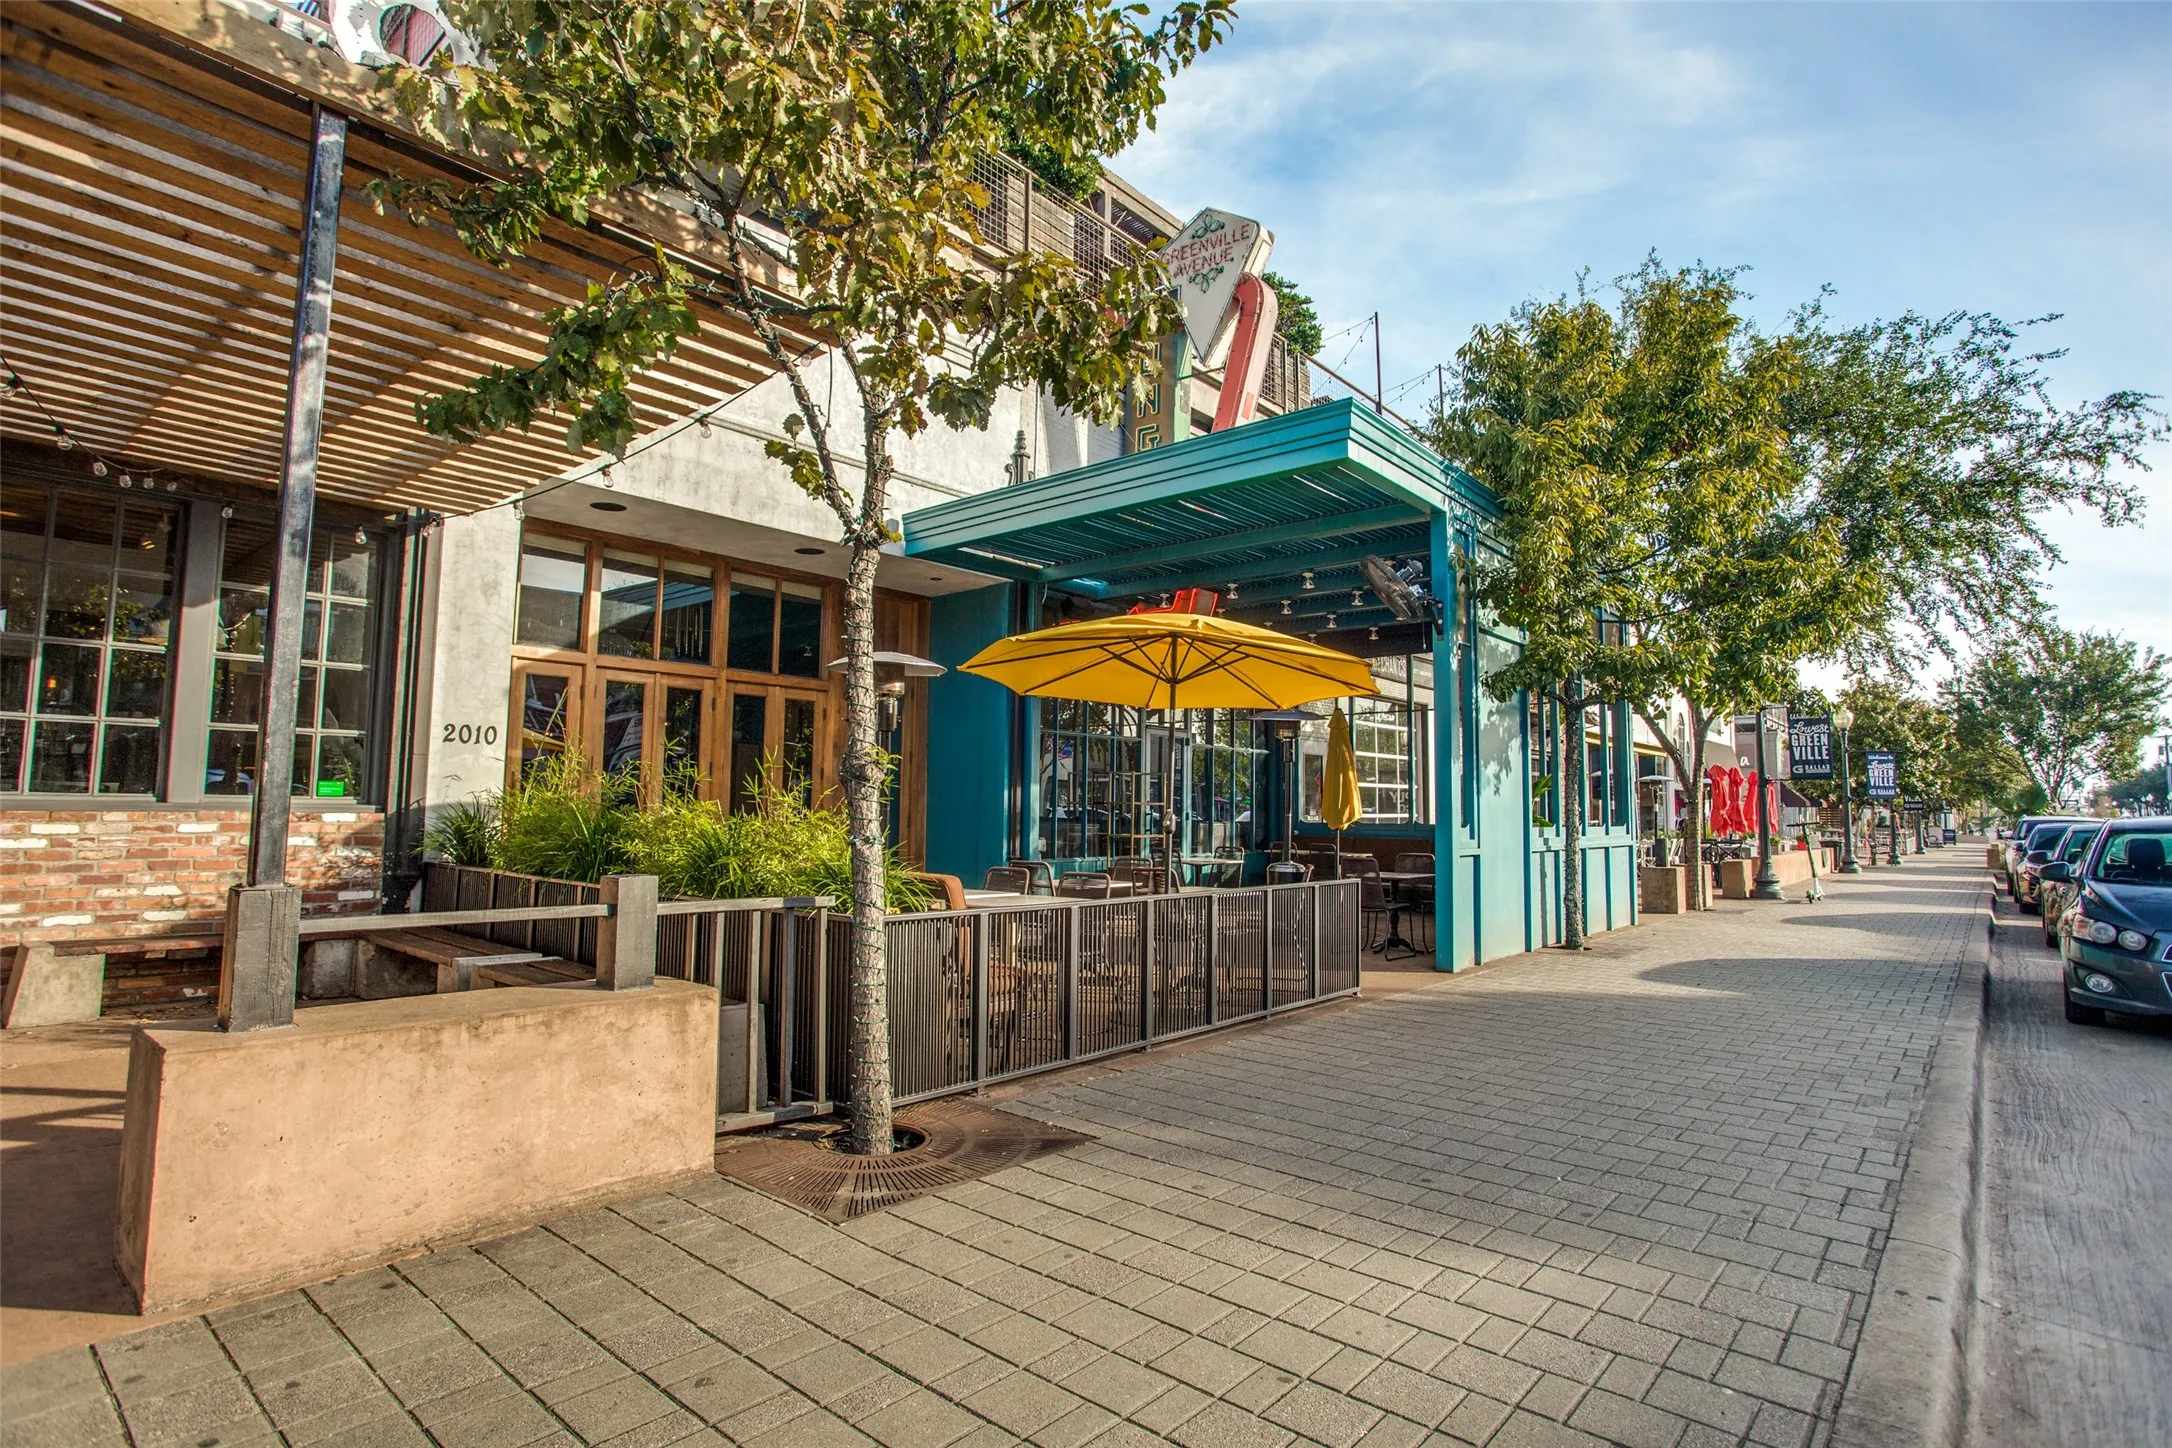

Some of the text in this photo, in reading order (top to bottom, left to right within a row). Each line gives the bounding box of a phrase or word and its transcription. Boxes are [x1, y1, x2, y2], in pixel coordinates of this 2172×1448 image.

[1161, 223, 1250, 266] GREENVILLE
[1173, 246, 1235, 279] AVENUE
[442, 723, 498, 745] 2010
[1789, 721, 1830, 737] Lowest
[1791, 733, 1829, 747] GREEN
[1792, 745, 1830, 760] VILLE
[1868, 768, 1894, 777] GREEN
[1869, 776, 1895, 787] VILLE
